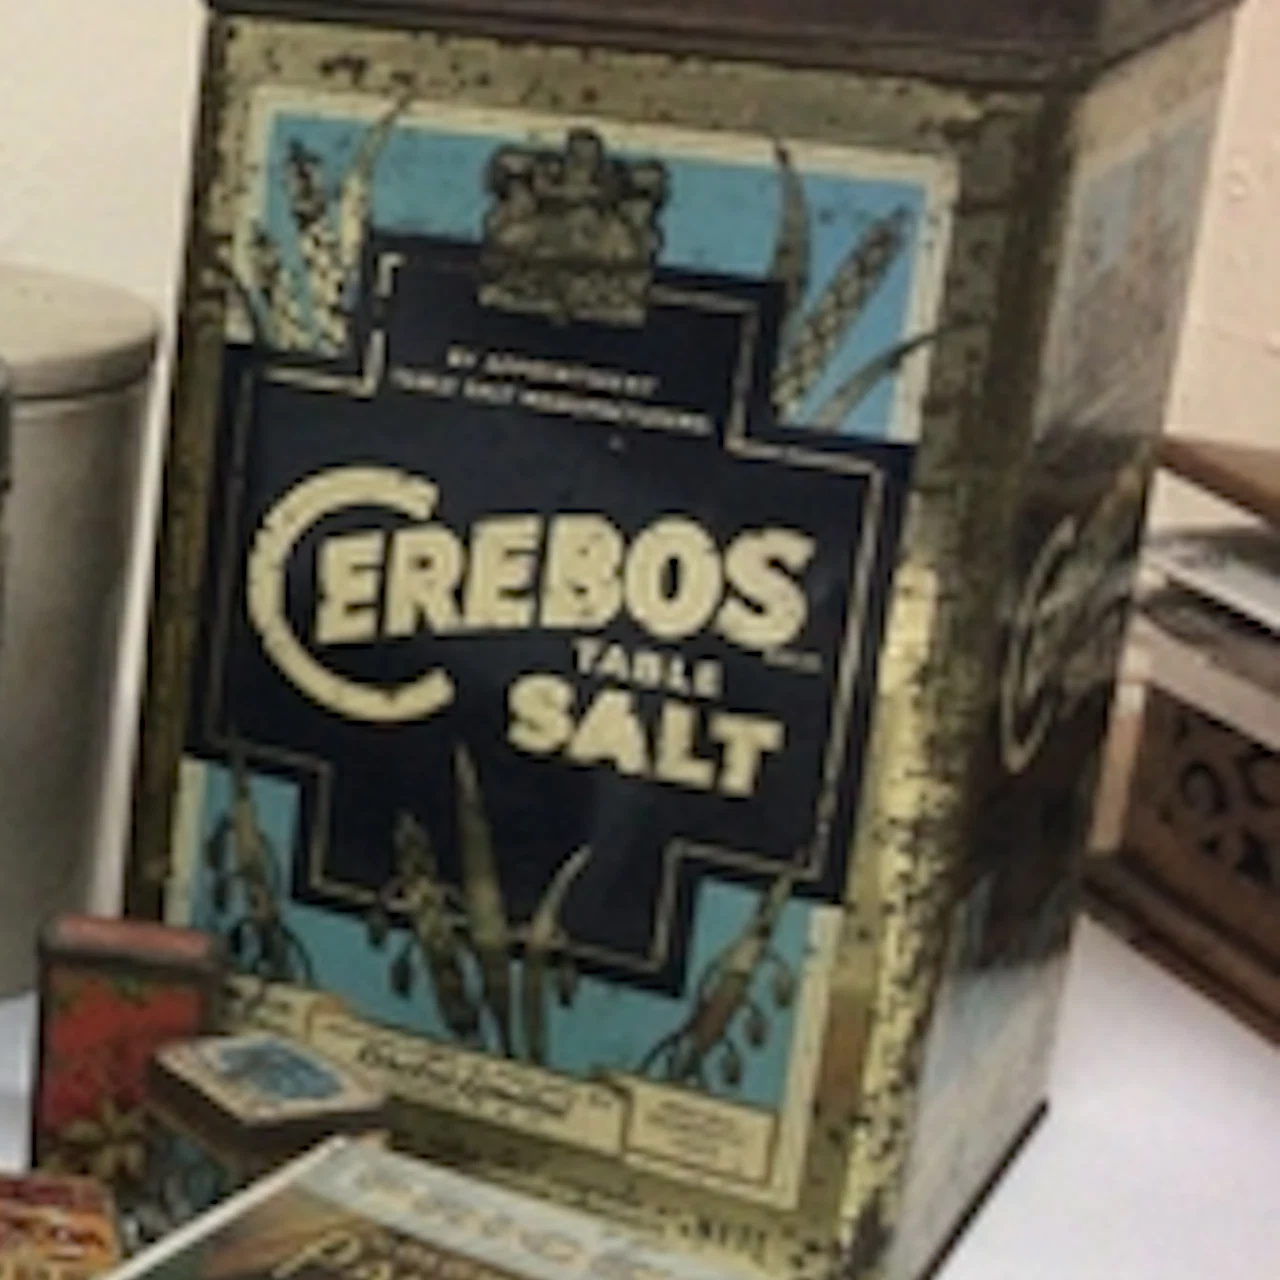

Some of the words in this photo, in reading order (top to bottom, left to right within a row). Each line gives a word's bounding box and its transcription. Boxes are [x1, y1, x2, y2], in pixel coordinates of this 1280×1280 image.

[246, 463, 818, 722] CEREBOS
[572, 638, 724, 698] TABLE
[506, 672, 784, 798] SALT
